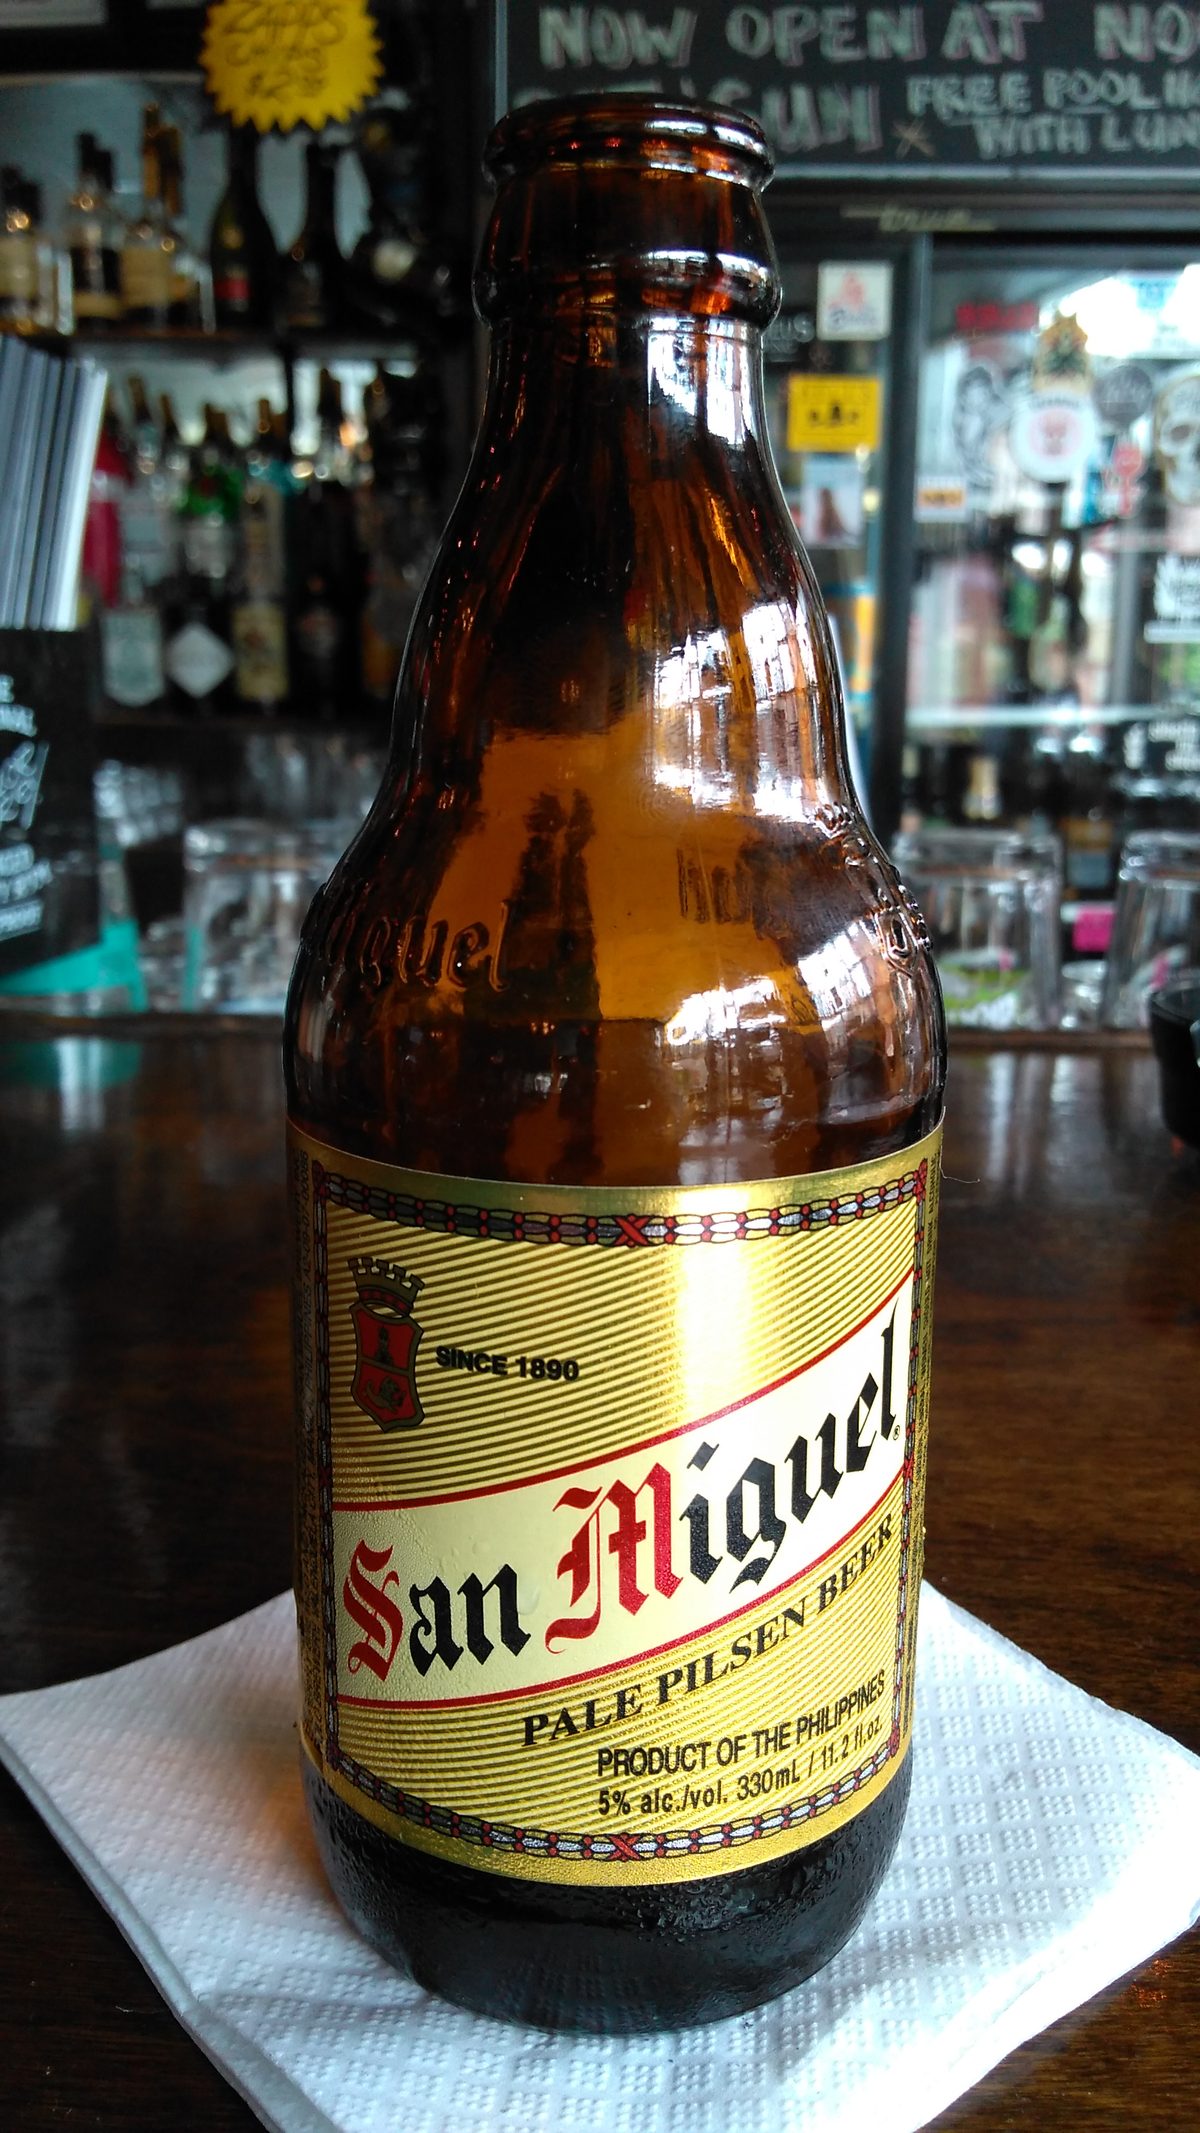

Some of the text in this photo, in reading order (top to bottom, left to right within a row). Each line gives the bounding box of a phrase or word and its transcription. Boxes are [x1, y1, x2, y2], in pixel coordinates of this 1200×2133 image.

[538, 2, 1200, 70] NOW OPEN AT NO
[906, 70, 1032, 121] FREE
[1043, 67, 1161, 110] POOL
[975, 114, 1091, 159] WITH
[436, 1345, 580, 1381] SINCE 1890
[343, 1540, 532, 1682] San
[545, 1297, 900, 1655] Miguel
[520, 1512, 893, 1747] PALE PILSEN BEER
[597, 1668, 886, 1777] PRODUCT OF THE PHILIPPINES
[599, 1789, 632, 1817] 5%
[640, 1780, 729, 1815] alc./vol.
[737, 1763, 801, 1803] 330mL
